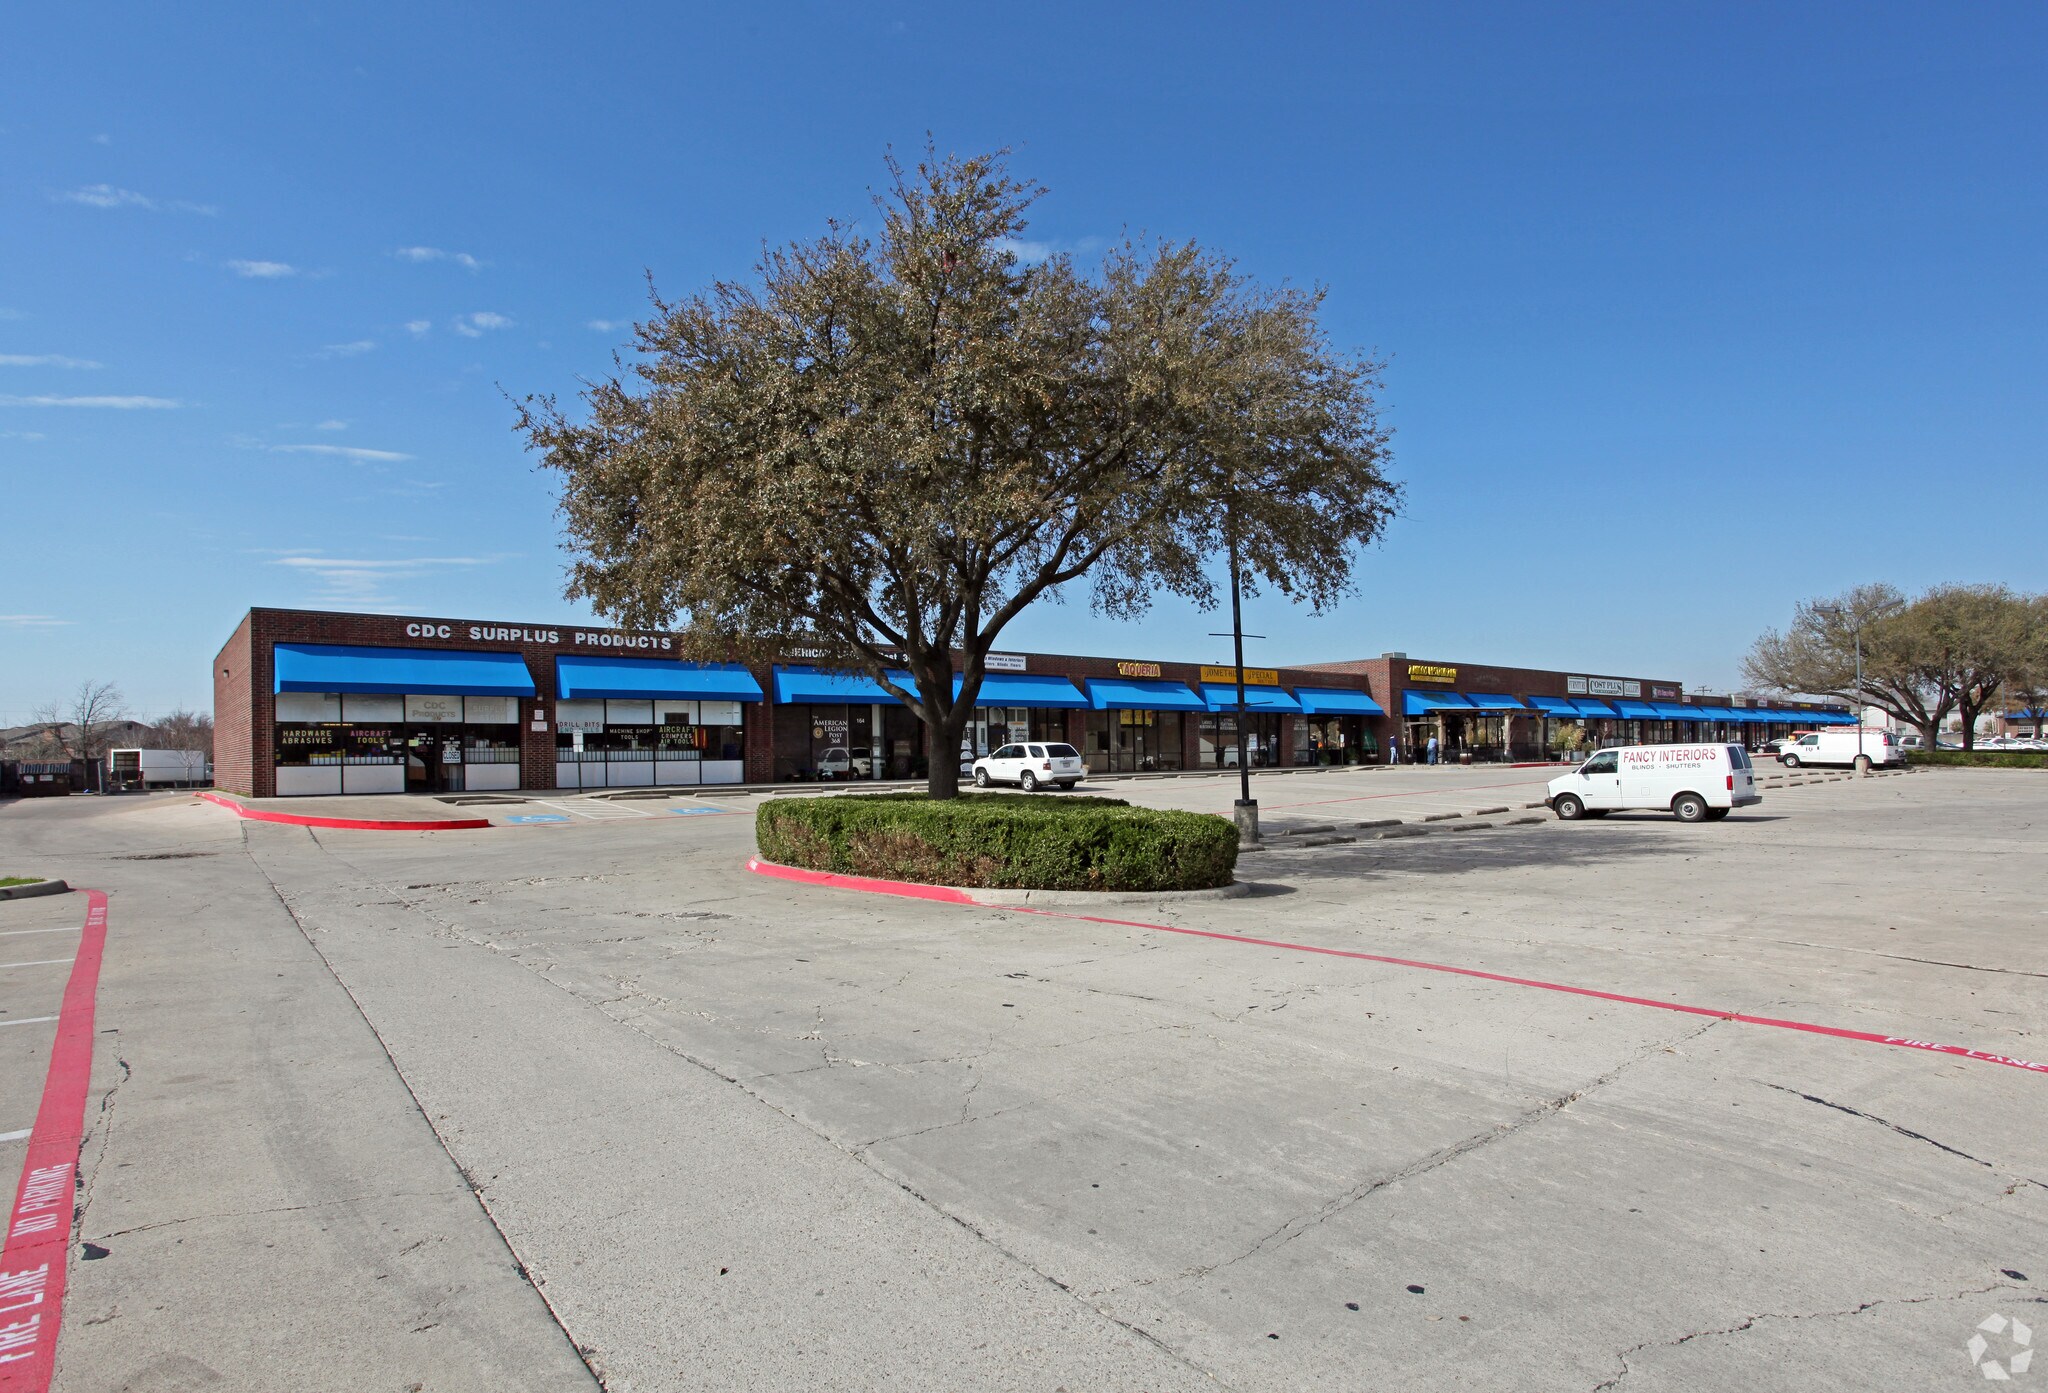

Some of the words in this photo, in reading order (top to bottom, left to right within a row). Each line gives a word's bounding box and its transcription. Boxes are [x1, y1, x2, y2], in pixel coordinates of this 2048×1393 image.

[406, 623, 451, 638] CDC
[469, 626, 559, 643] SURPLUS
[574, 632, 672, 649] PRODUCTS
[1117, 662, 1161, 677] TAQUERIA
[1590, 680, 1606, 693] COST
[1607, 682, 1622, 694] PLUS
[423, 701, 446, 709] CDC
[1623, 751, 1656, 763] FANCY
[1659, 748, 1717, 762] INTERIORS
[1884, 1036, 1951, 1051] FIRE
[1965, 1049, 2048, 1071] LANE
[18, 1163, 73, 1213] PARKING
[11, 1213, 58, 1237] NO
